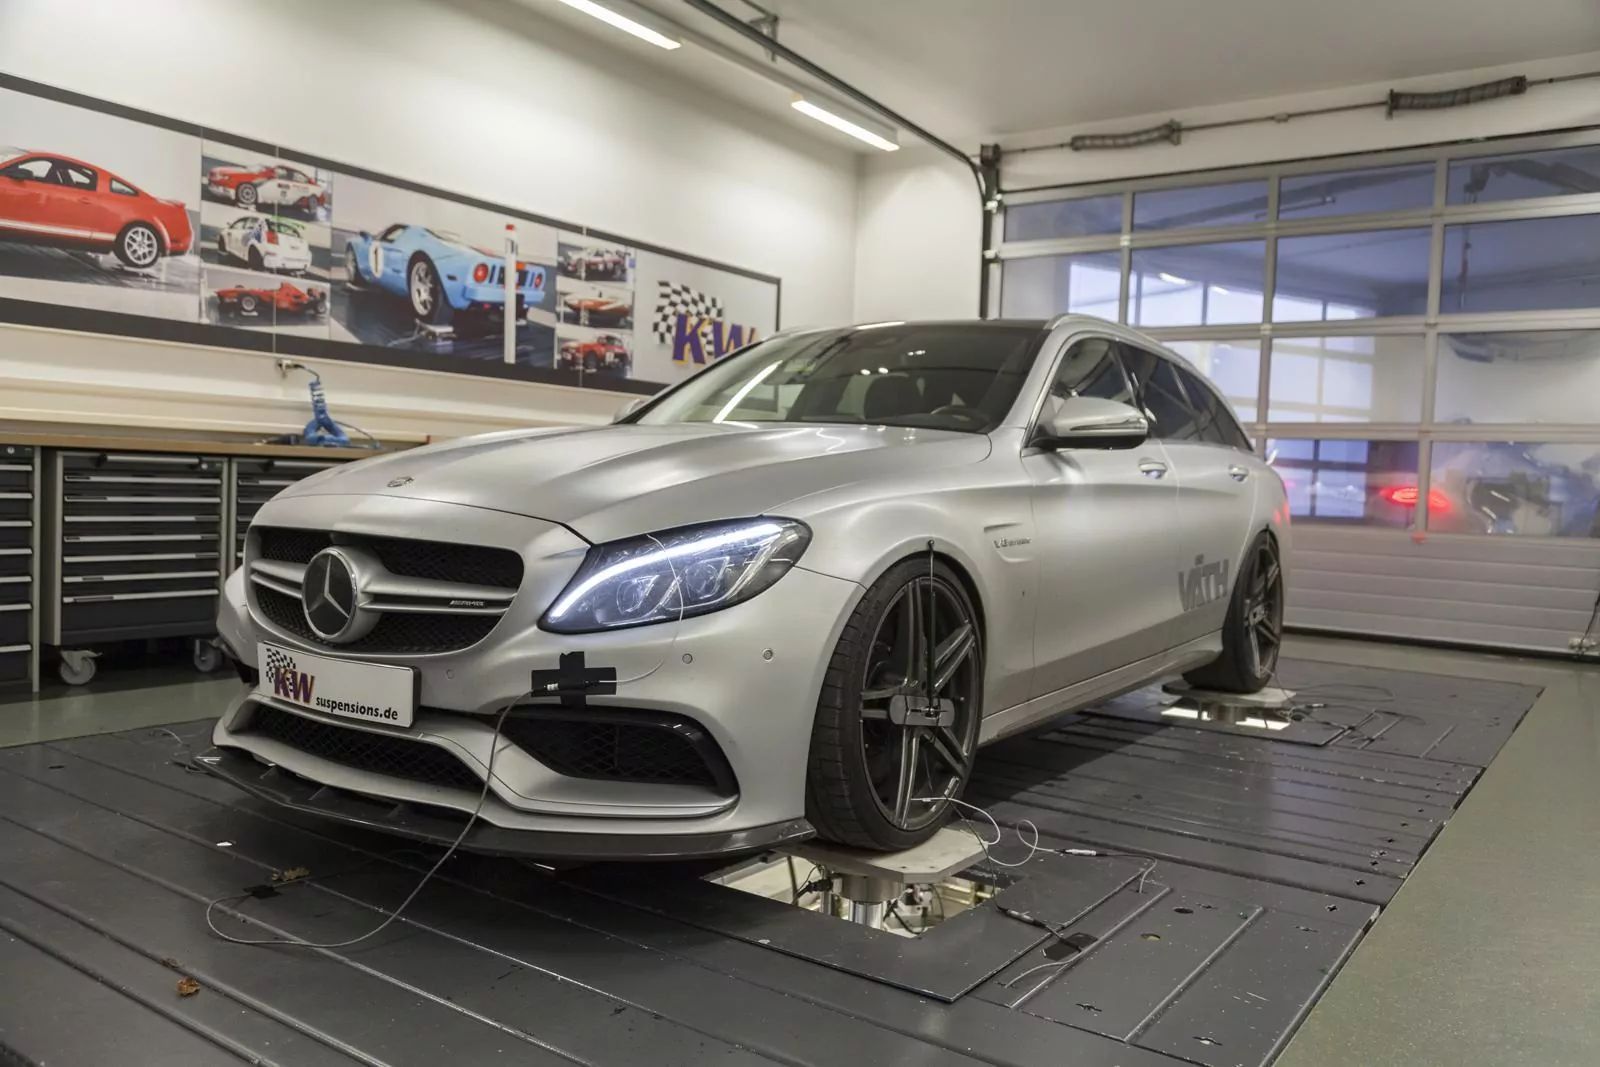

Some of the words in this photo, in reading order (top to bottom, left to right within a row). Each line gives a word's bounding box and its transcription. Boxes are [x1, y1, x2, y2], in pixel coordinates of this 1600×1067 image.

[672, 312, 757, 365] KW
[273, 666, 315, 705] KW
[316, 696, 398, 720] suspensions.de
